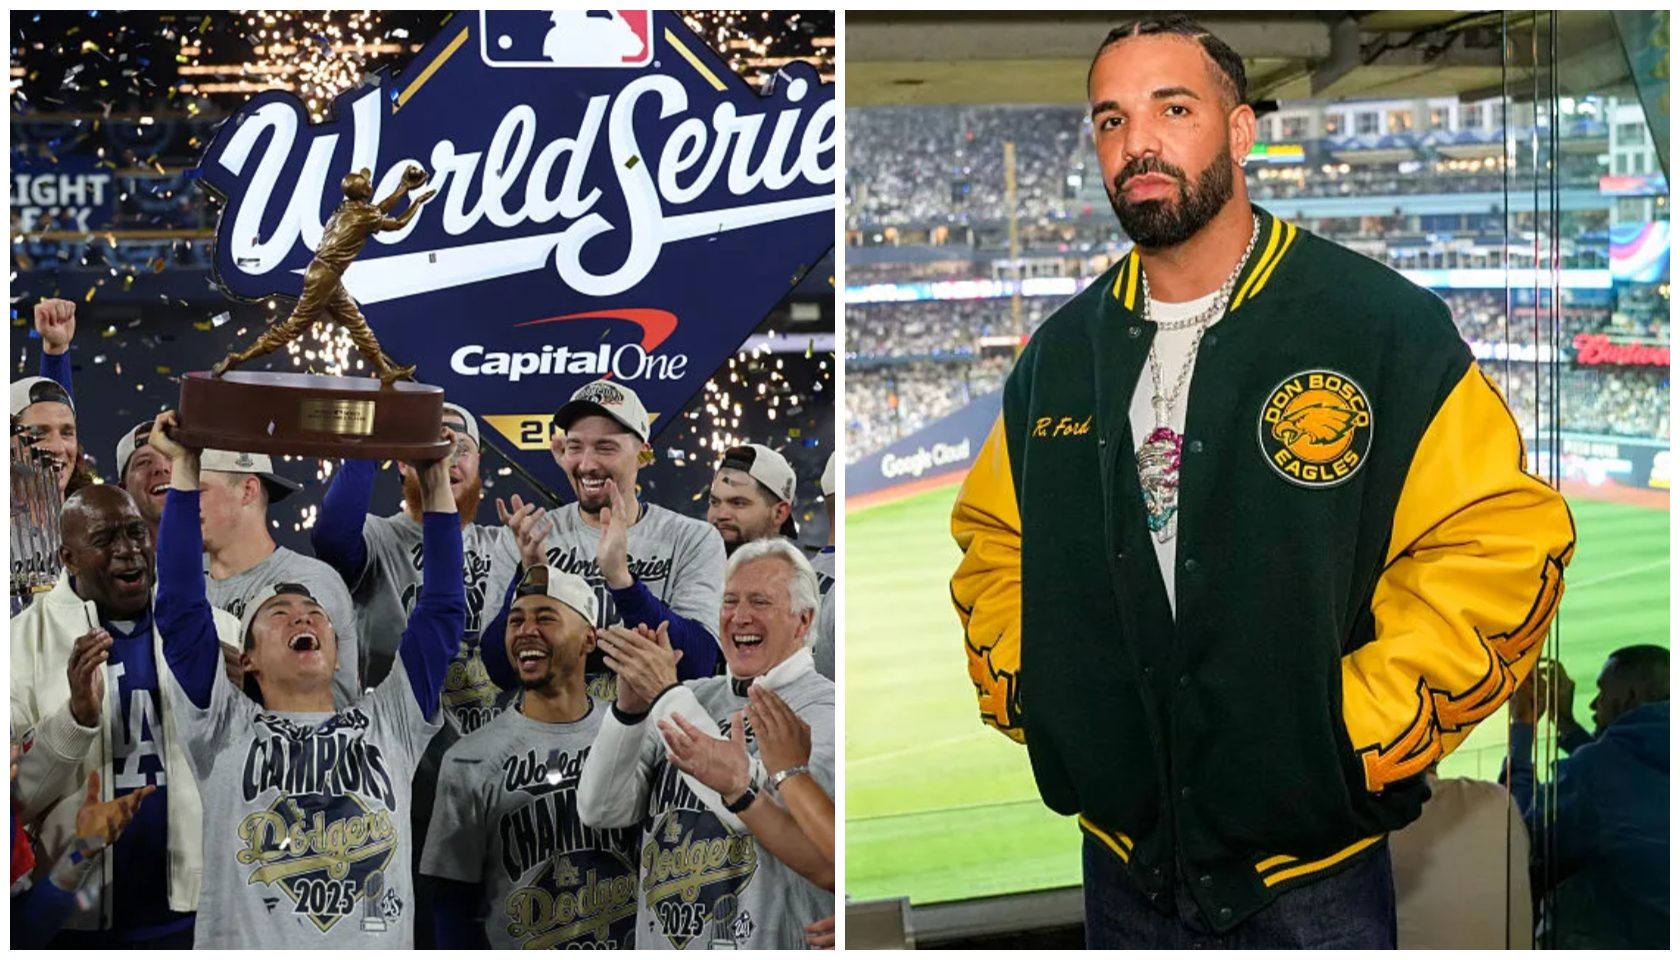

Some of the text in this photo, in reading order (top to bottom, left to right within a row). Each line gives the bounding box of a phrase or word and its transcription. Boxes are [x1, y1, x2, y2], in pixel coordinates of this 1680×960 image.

[10, 173, 110, 206] IGHT
[216, 88, 610, 277] World
[1264, 374, 1370, 428] DON BOSCO
[1053, 414, 1093, 438] Ford
[881, 437, 971, 479] Google Cloud
[1273, 448, 1360, 481] EAGLES
[502, 748, 584, 792] Wold
[236, 809, 399, 882] Dodgers
[292, 879, 358, 916] 2025
[660, 902, 706, 938] 2025
